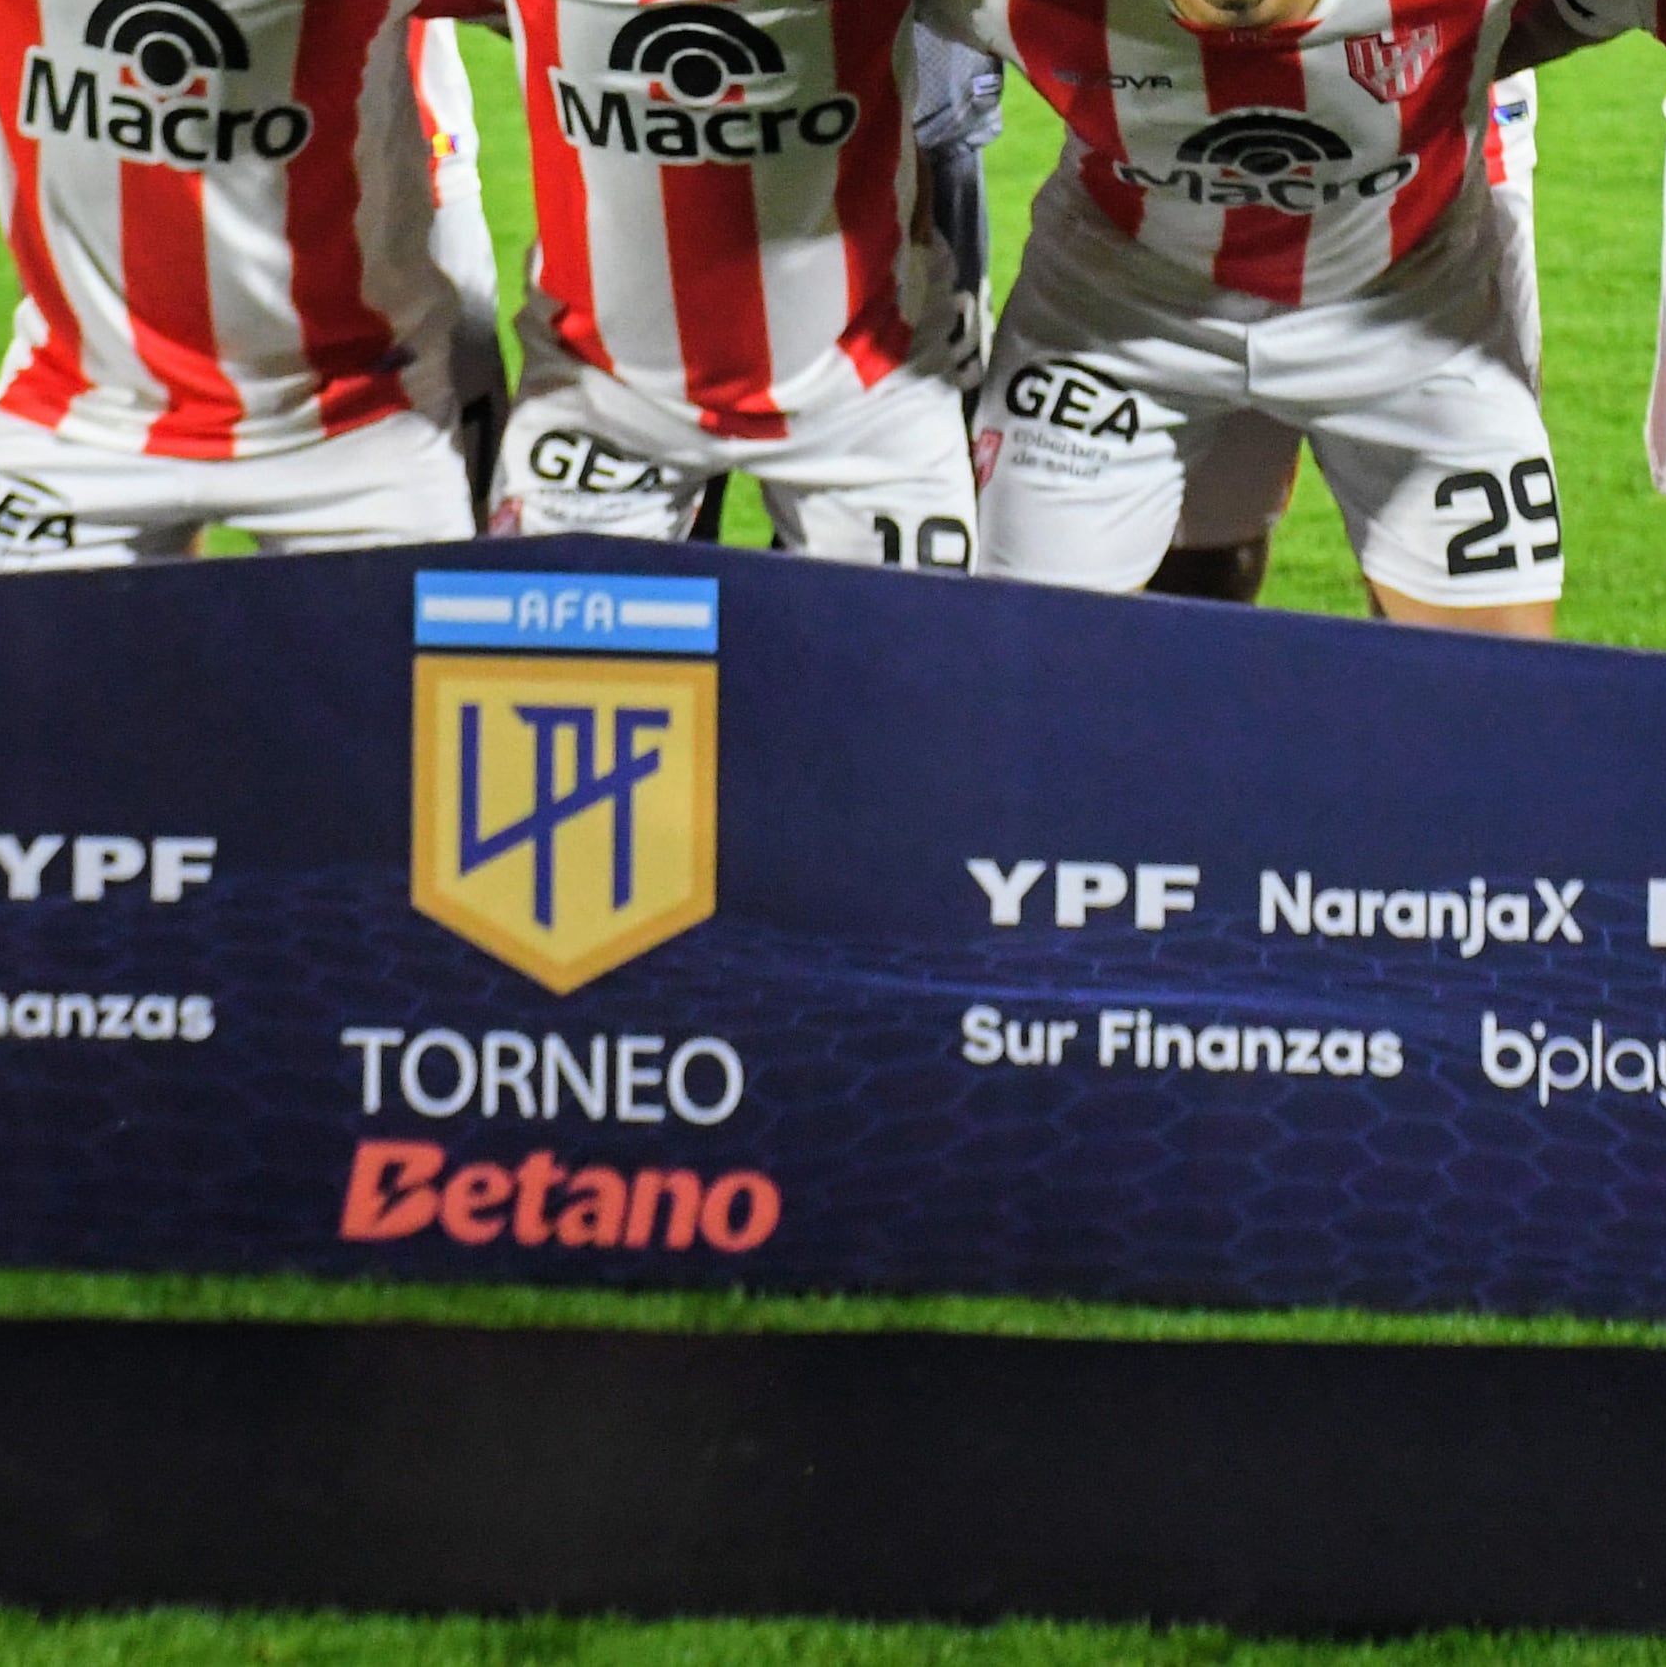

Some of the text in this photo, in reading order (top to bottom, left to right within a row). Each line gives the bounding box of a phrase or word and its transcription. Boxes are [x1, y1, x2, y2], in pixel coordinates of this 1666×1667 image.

[25, 56, 310, 162] Macro
[557, 80, 858, 159] Macro
[1004, 364, 1140, 444] GEA
[1435, 456, 1561, 577] 29
[516, 589, 615, 632] AFA
[965, 857, 1201, 931] YPF
[1258, 869, 1585, 958] NaranjaX
[339, 1026, 746, 1126] TORNEO
[961, 1003, 1405, 1078] Sur Finanzas
[339, 1138, 782, 1253] Betano
